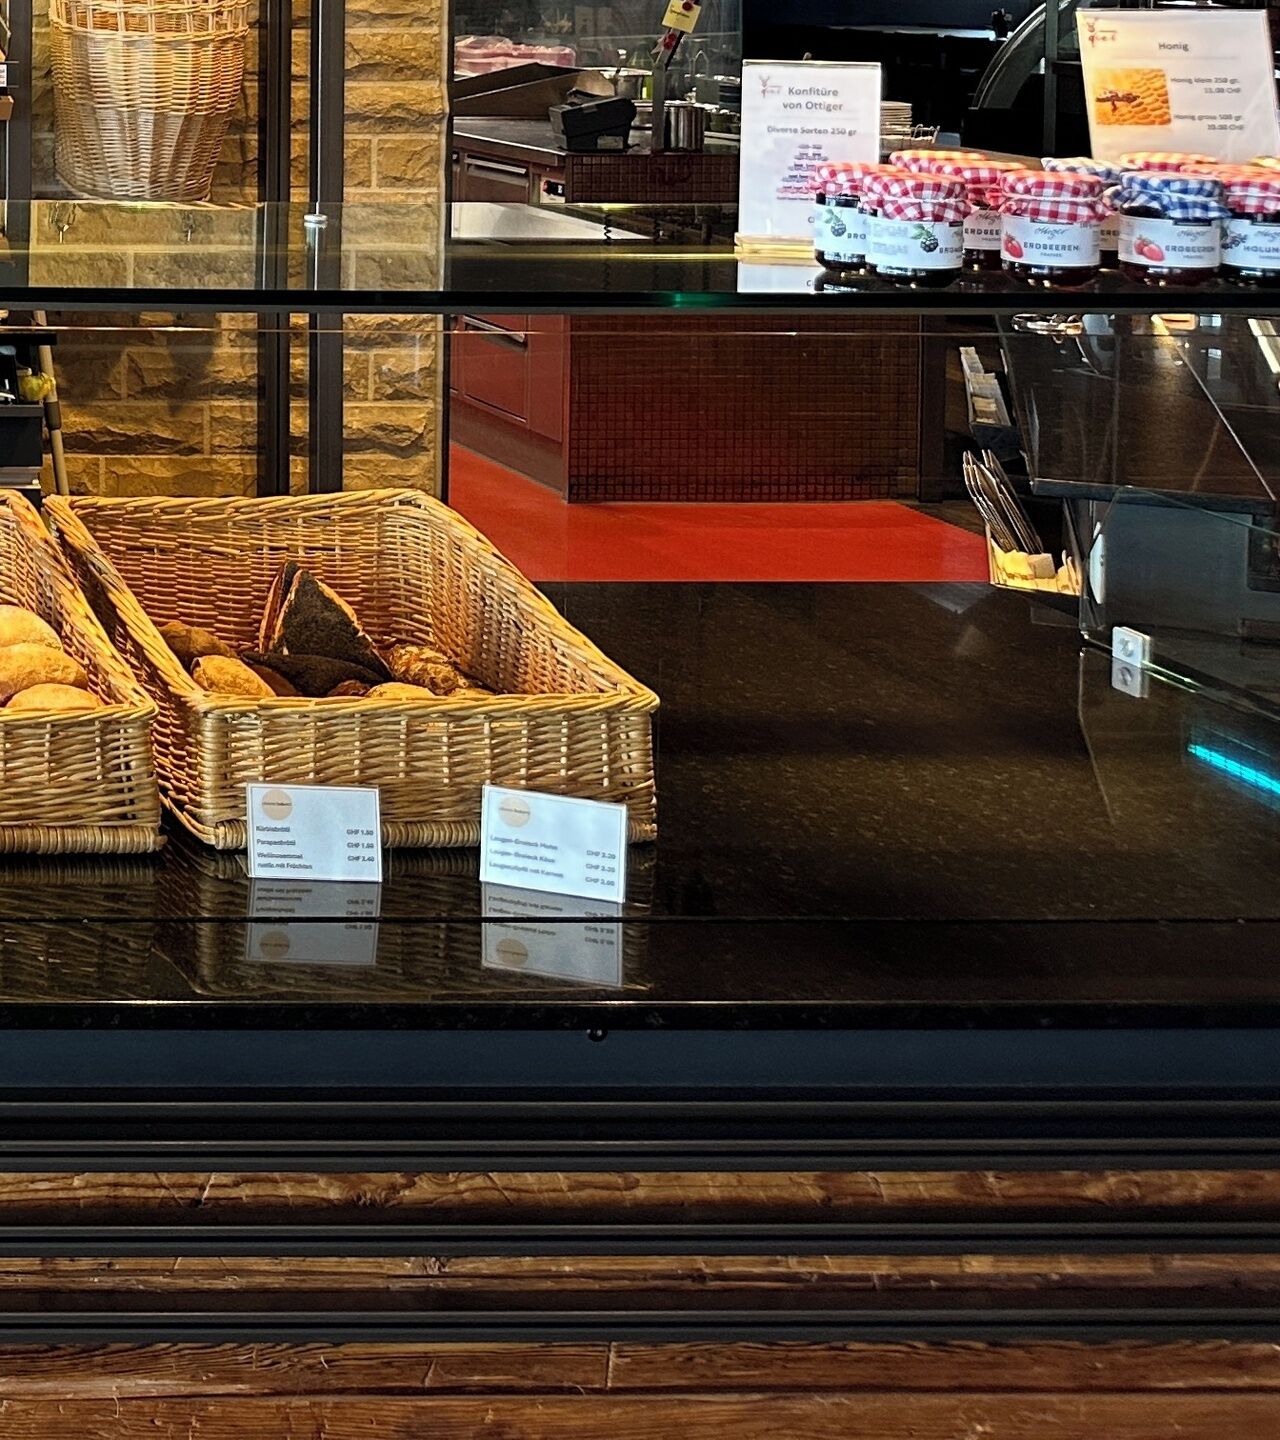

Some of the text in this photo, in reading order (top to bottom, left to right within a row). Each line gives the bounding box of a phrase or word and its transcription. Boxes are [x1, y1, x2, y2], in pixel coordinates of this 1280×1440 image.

[1158, 42, 1189, 52] Honig
[788, 87, 839, 97] Konfitüre
[805, 101, 844, 112] Ottiger
[767, 126, 798, 134] Diverse
[800, 126, 829, 135] Sorten
[1023, 241, 1080, 251] ERDBEEREN
[1165, 244, 1215, 253] ERDBEEREN
